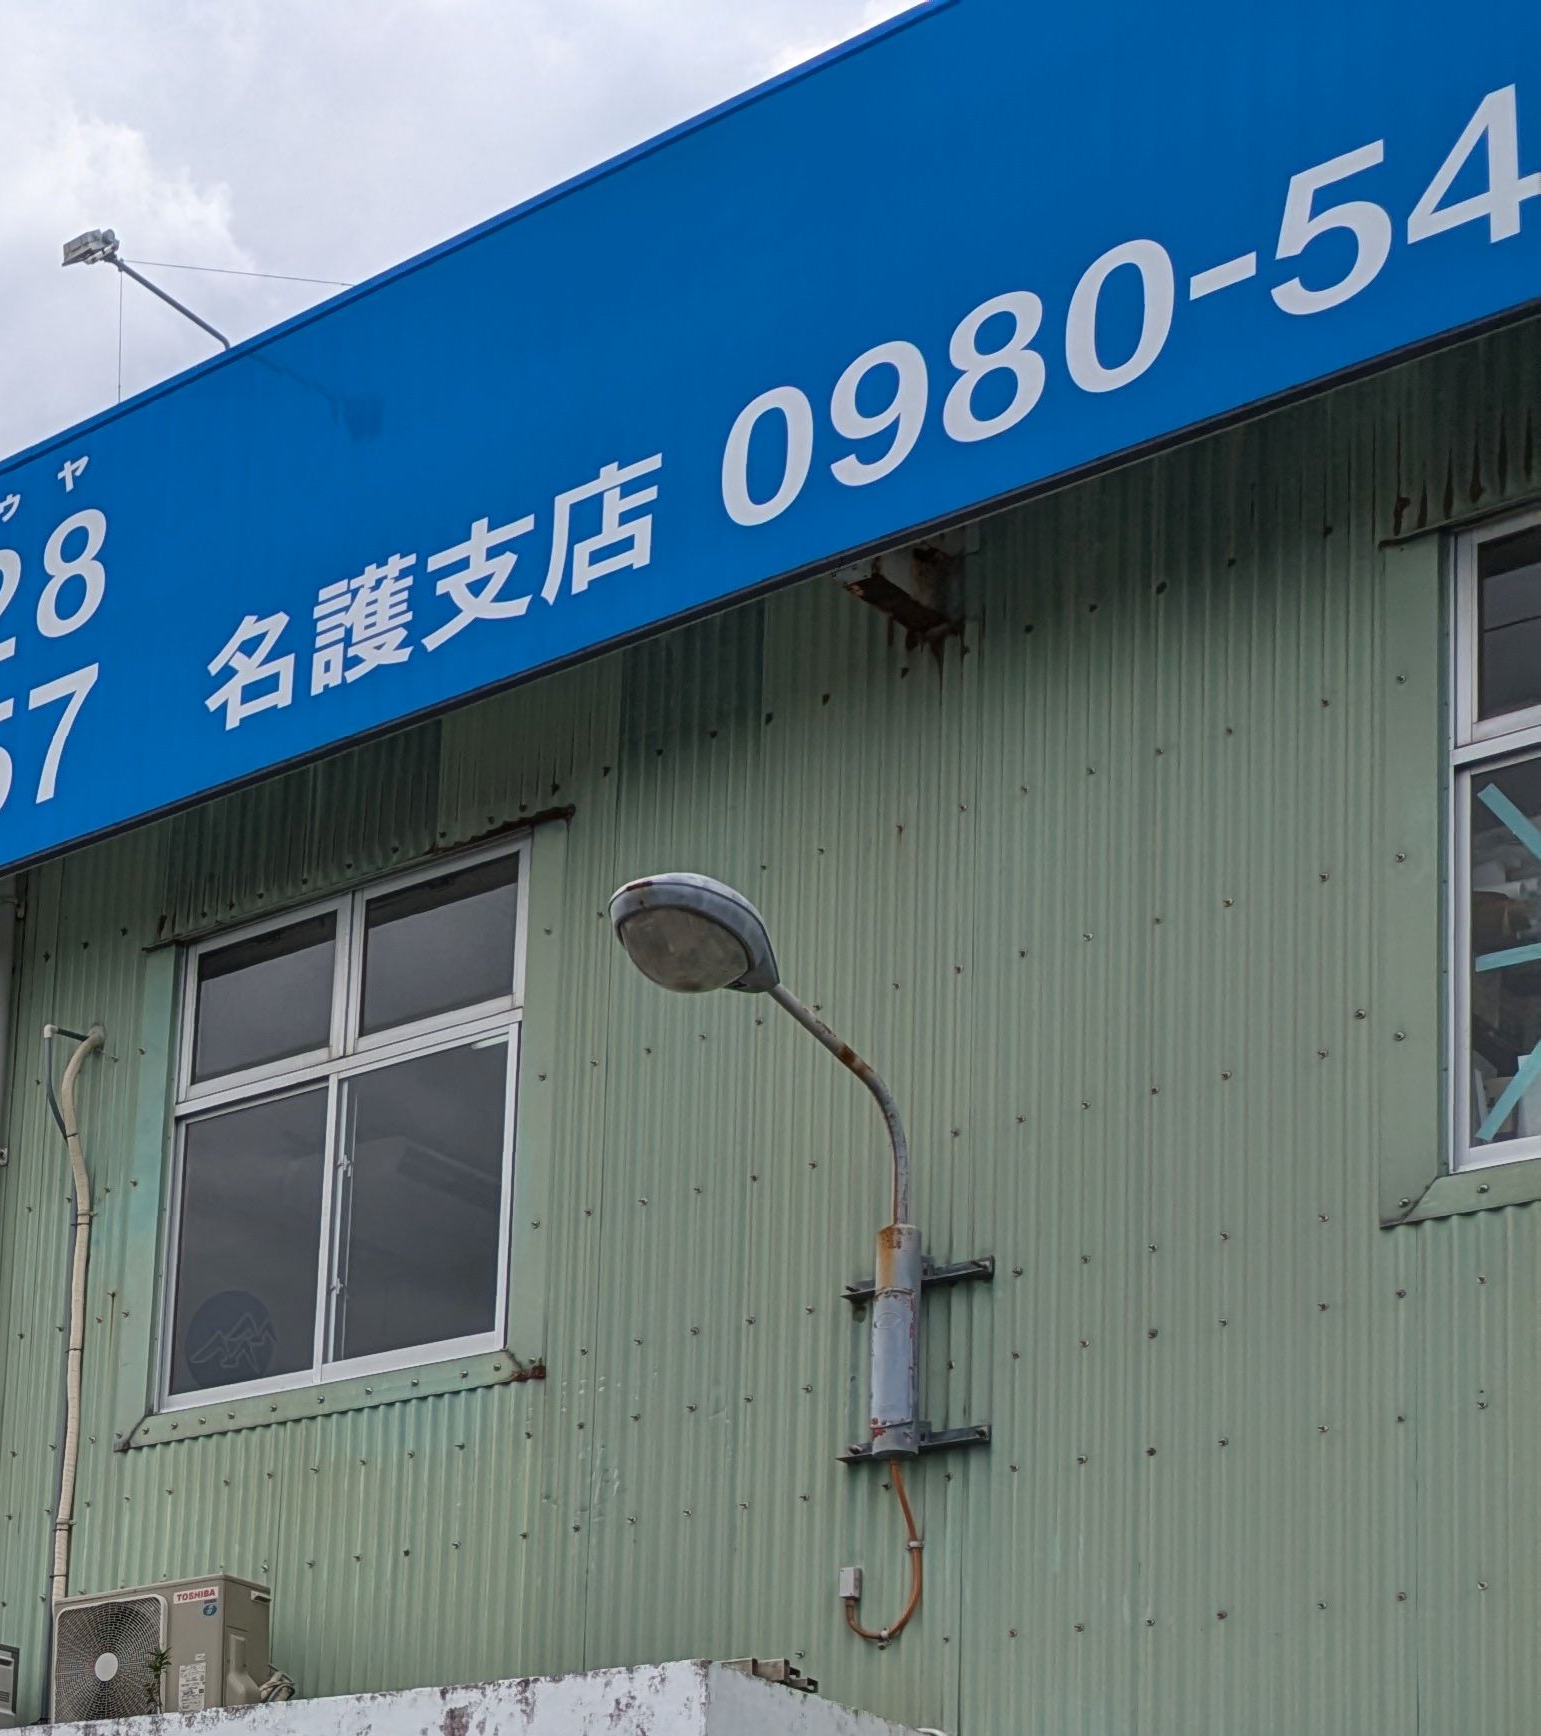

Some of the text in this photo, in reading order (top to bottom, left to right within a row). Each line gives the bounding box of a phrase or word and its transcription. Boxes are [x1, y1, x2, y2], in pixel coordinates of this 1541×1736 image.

[205, 85, 1541, 730] 名護支店 0980-54
[176, 1588, 216, 1602] TOSHIBA
